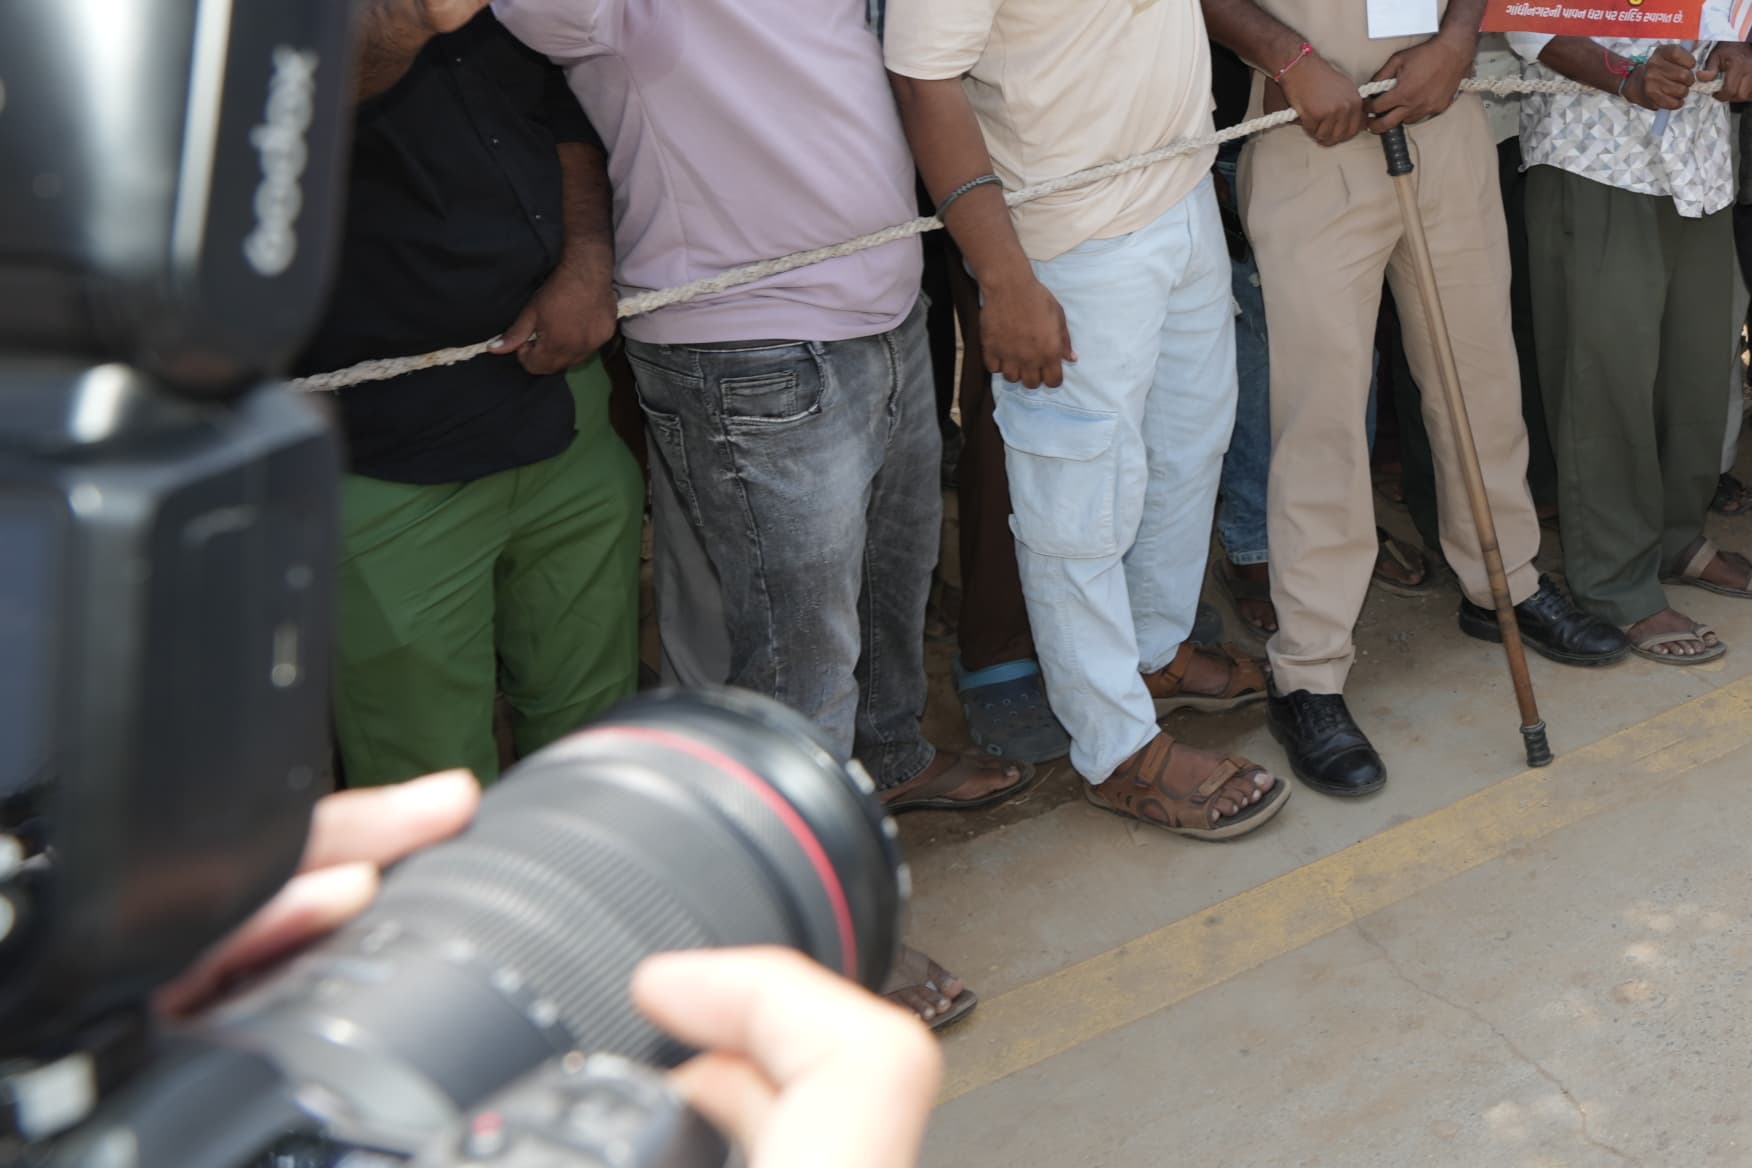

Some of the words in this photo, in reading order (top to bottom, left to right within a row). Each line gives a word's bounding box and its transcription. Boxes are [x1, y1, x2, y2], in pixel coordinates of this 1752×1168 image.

[1506, 3, 1562, 18] ગાંધીનગરની
[1562, 7, 1586, 19] પાવન
[1587, 8, 1604, 20] ધરા
[1605, 9, 1617, 21] પર
[1643, 10, 1672, 23] સ્વાગત
